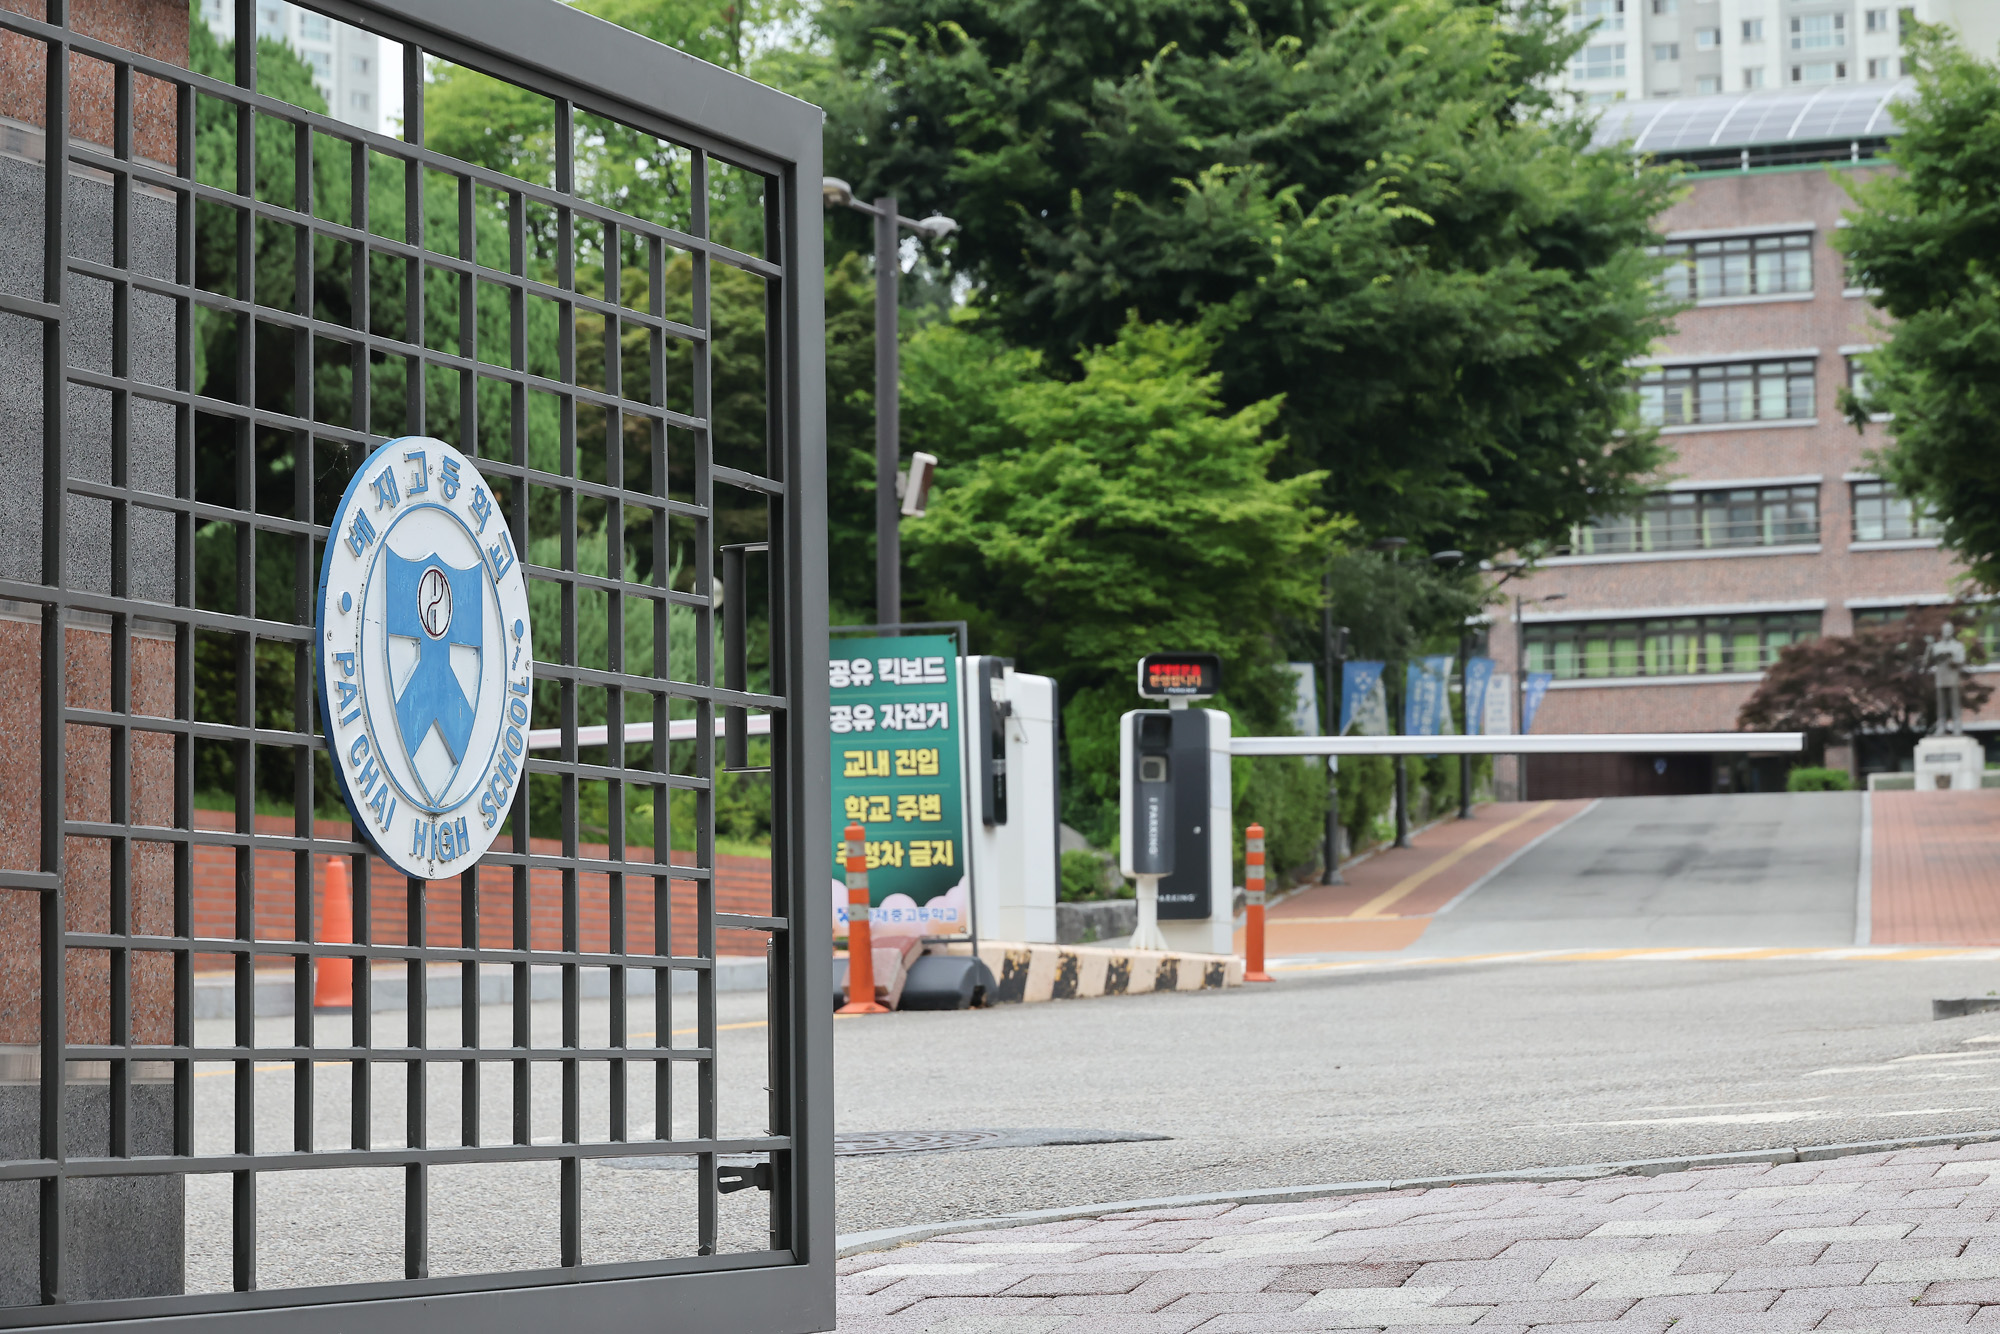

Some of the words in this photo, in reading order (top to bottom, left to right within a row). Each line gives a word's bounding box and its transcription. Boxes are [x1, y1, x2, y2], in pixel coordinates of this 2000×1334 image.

[344, 450, 514, 581] 배재고등학교
[829, 658, 874, 688] 공유
[877, 657, 947, 685] 킥보드
[830, 704, 876, 733] 공유
[879, 702, 948, 730] 자전거
[333, 651, 361, 728] PAI
[349, 734, 396, 832] CHAI
[410, 816, 470, 862] HIGH
[478, 676, 530, 830] SCHOOL
[843, 750, 890, 777] 교내
[895, 748, 939, 776] 진입
[844, 795, 892, 823] 학교
[896, 794, 942, 822] 주변
[908, 840, 954, 867] 금지
[1157, 894, 1196, 902] ARKING
